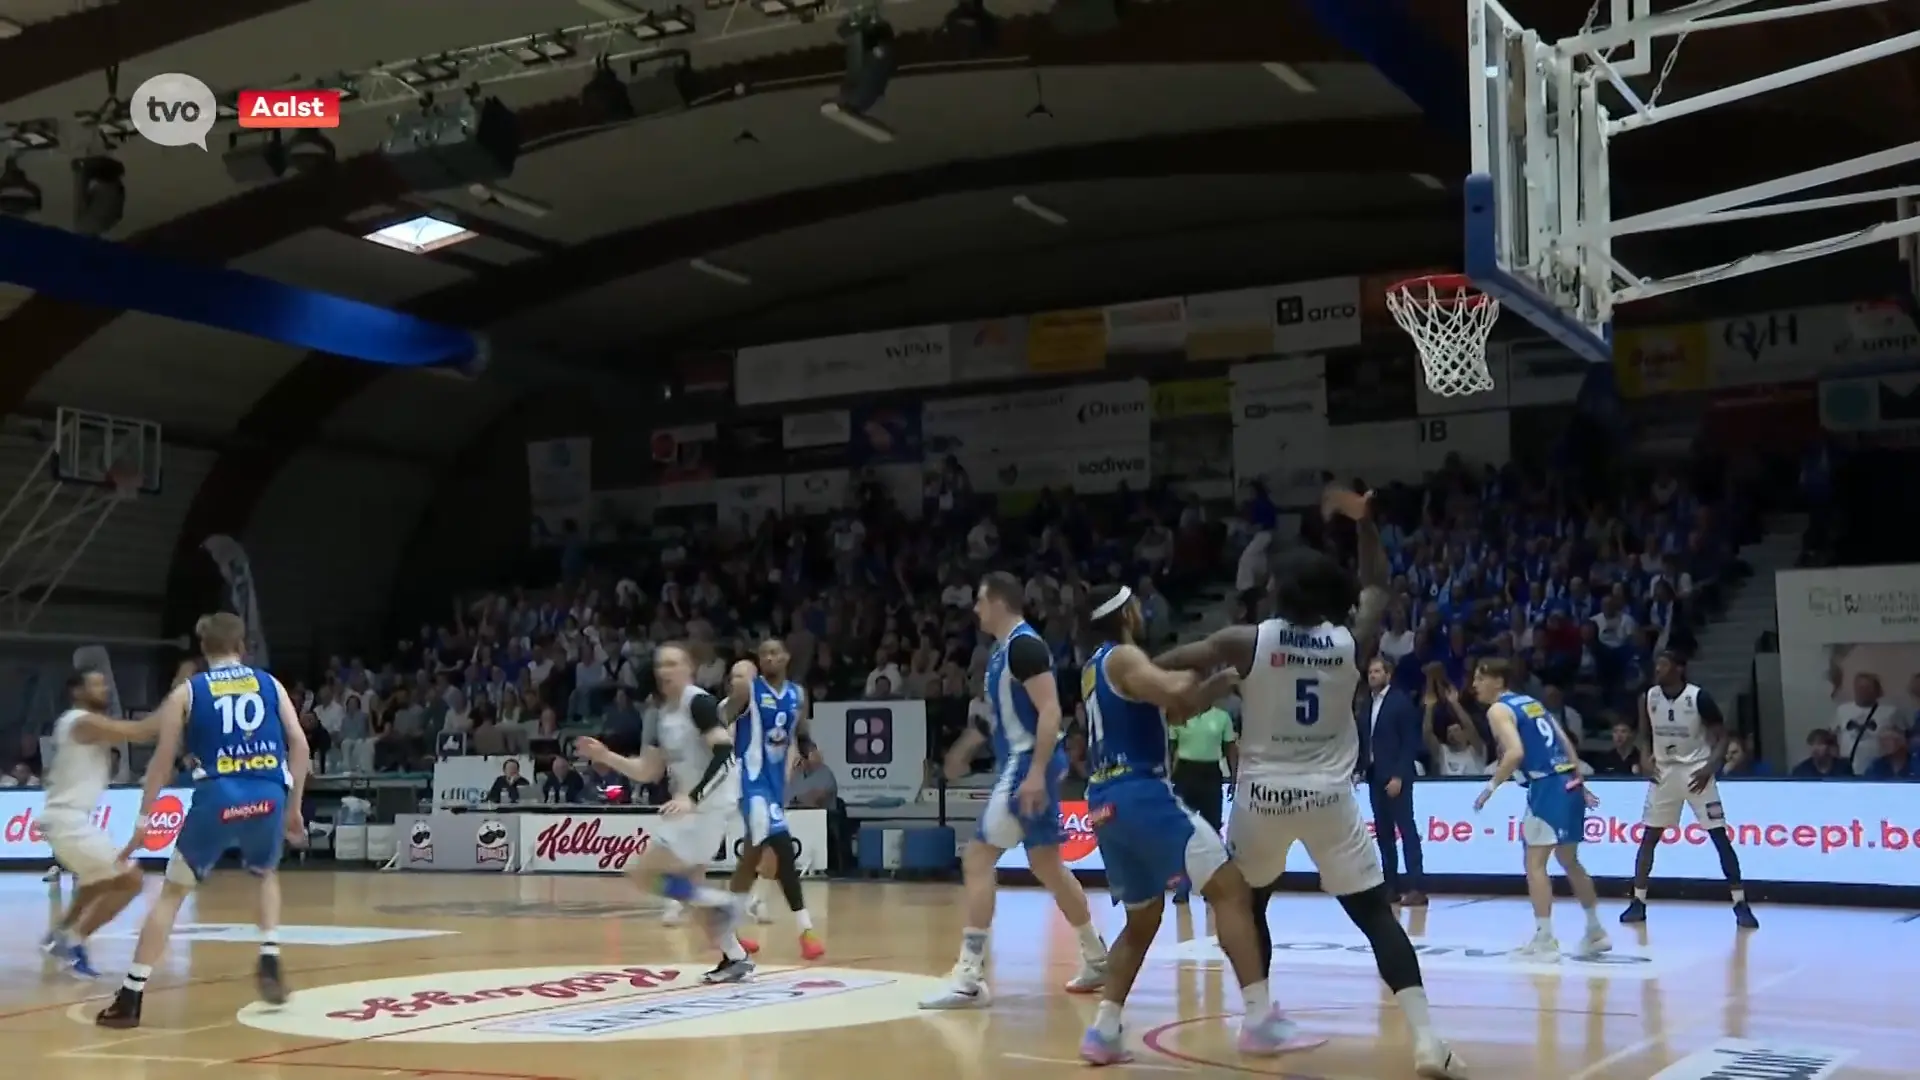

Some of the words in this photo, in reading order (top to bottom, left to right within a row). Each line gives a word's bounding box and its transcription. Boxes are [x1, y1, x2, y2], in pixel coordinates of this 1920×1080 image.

[1308, 304, 1356, 322] arco
[213, 693, 265, 733] 10
[1295, 678, 1320, 726] 5
[1536, 717, 1554, 748] 9
[216, 753, 278, 774] Brico
[850, 768, 888, 780] arco
[536, 817, 651, 869] Kellogg's
